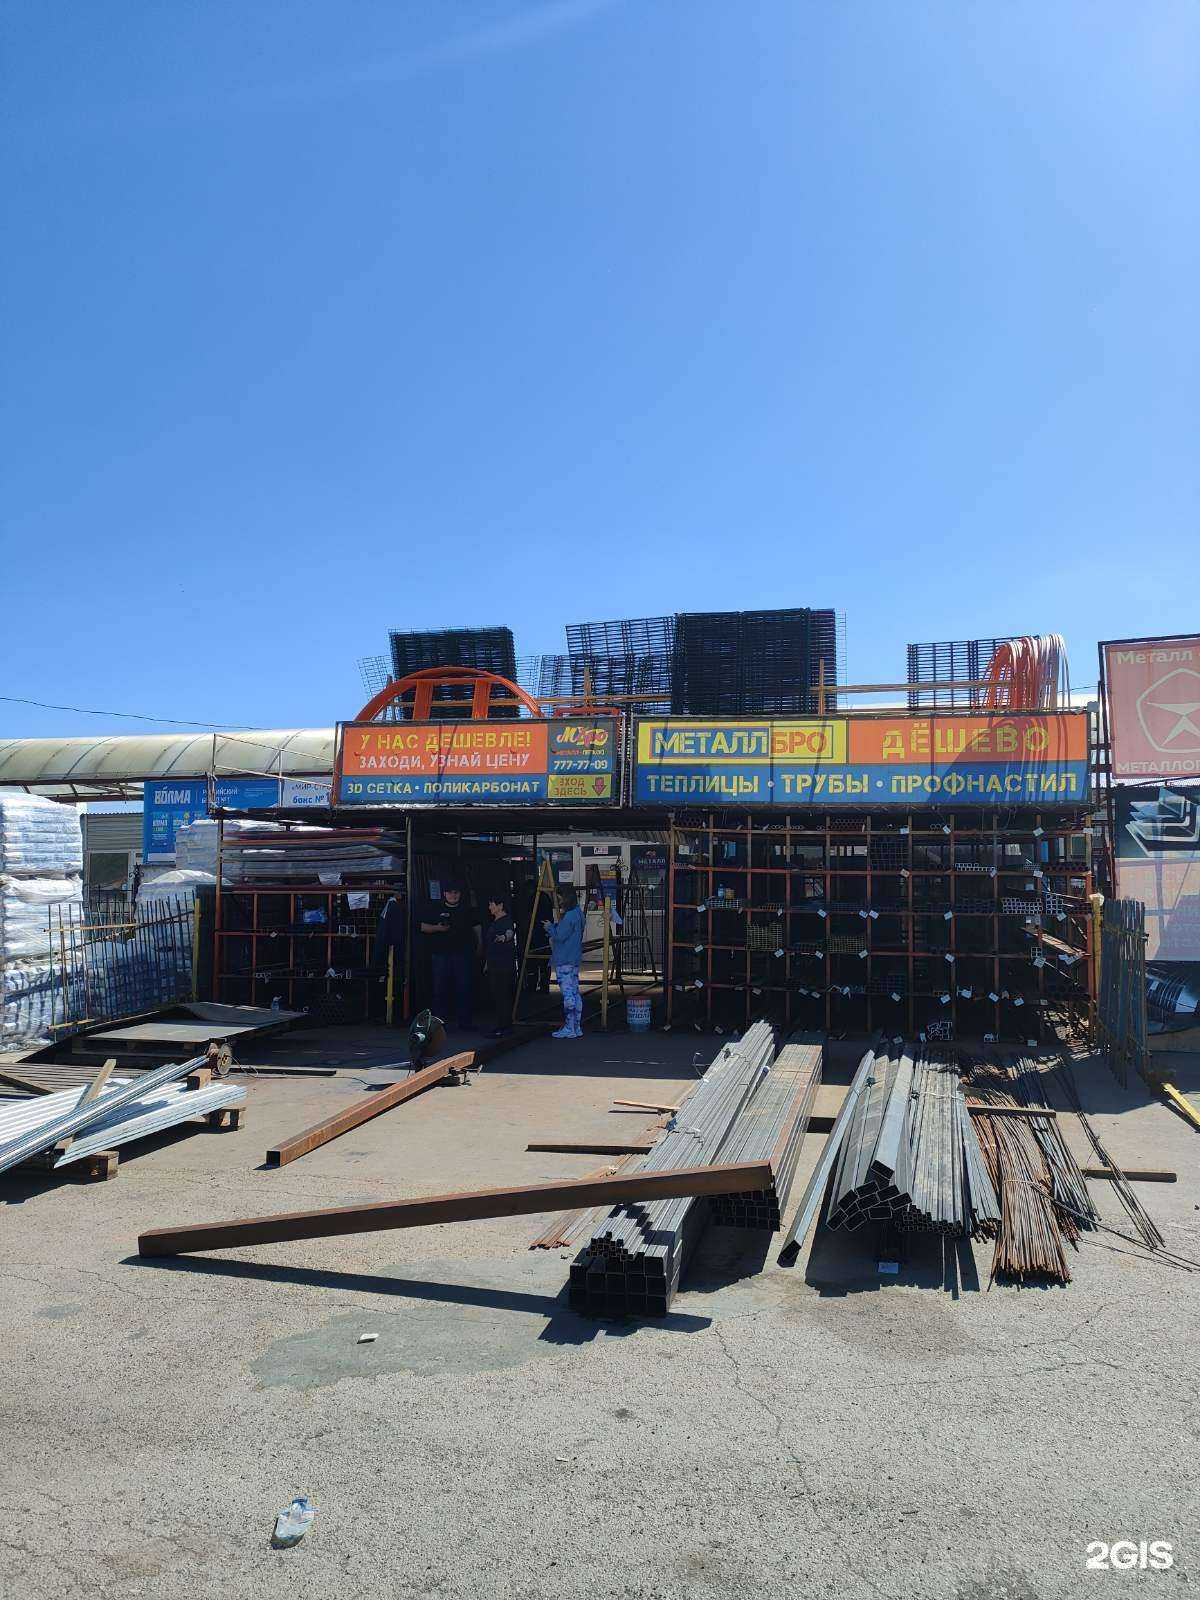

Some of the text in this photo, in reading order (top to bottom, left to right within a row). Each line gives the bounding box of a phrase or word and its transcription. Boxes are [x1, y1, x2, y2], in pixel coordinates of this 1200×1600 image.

[1117, 649, 1193, 665] Металл
[361, 731, 532, 751] У НАС ДЕШЕВЛЕ!
[882, 722, 1049, 760] ДЁШЕВО
[360, 752, 530, 770] ЗАХОДИ, УЗНАЙ ЦЕНУ
[347, 782, 540, 794] 3D СЕТКА ПОЛИКАРБОНАТ
[554, 787, 588, 797] ЗДЕСЬ
[646, 773, 1077, 797] ТЕПЛИЦЫ ТРУБЫ ПРОФНАСТИЛ
[293, 796, 313, 804] бокс
